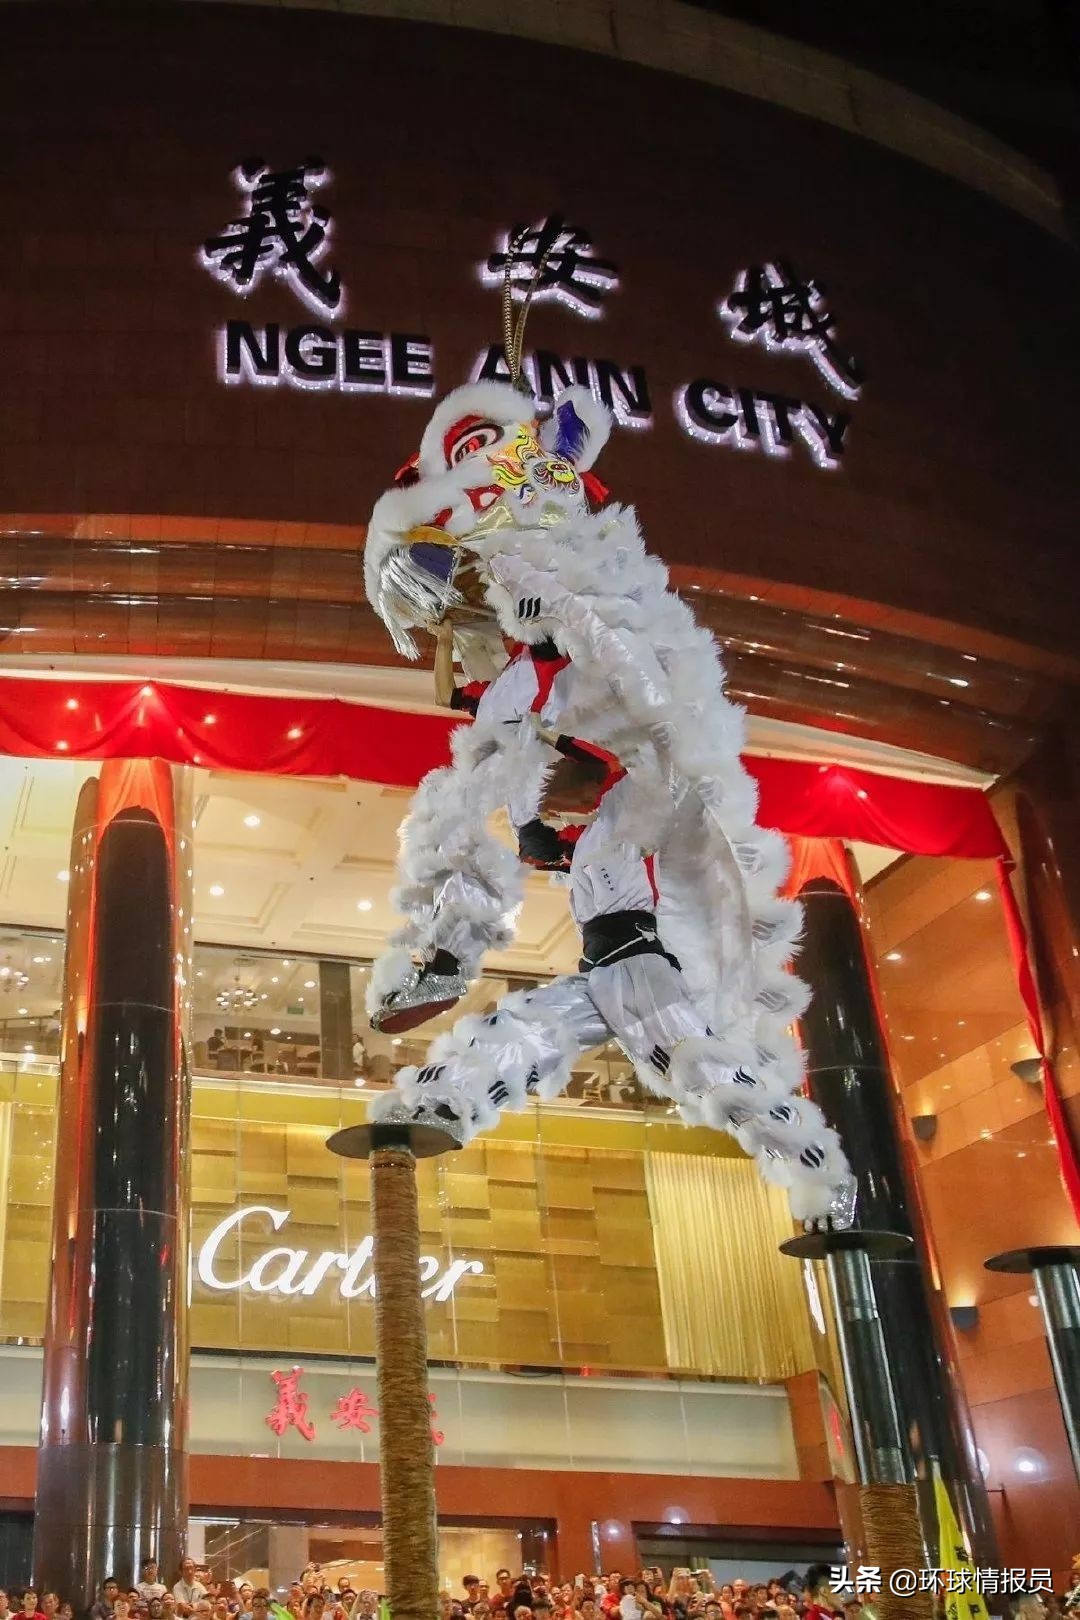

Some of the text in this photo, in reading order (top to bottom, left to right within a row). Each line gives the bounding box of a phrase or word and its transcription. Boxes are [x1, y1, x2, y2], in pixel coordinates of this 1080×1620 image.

[222, 320, 852, 466] NGEE ANN CITY
[198, 1206, 483, 1301] Carter
[265, 1366, 444, 1445] 義安
